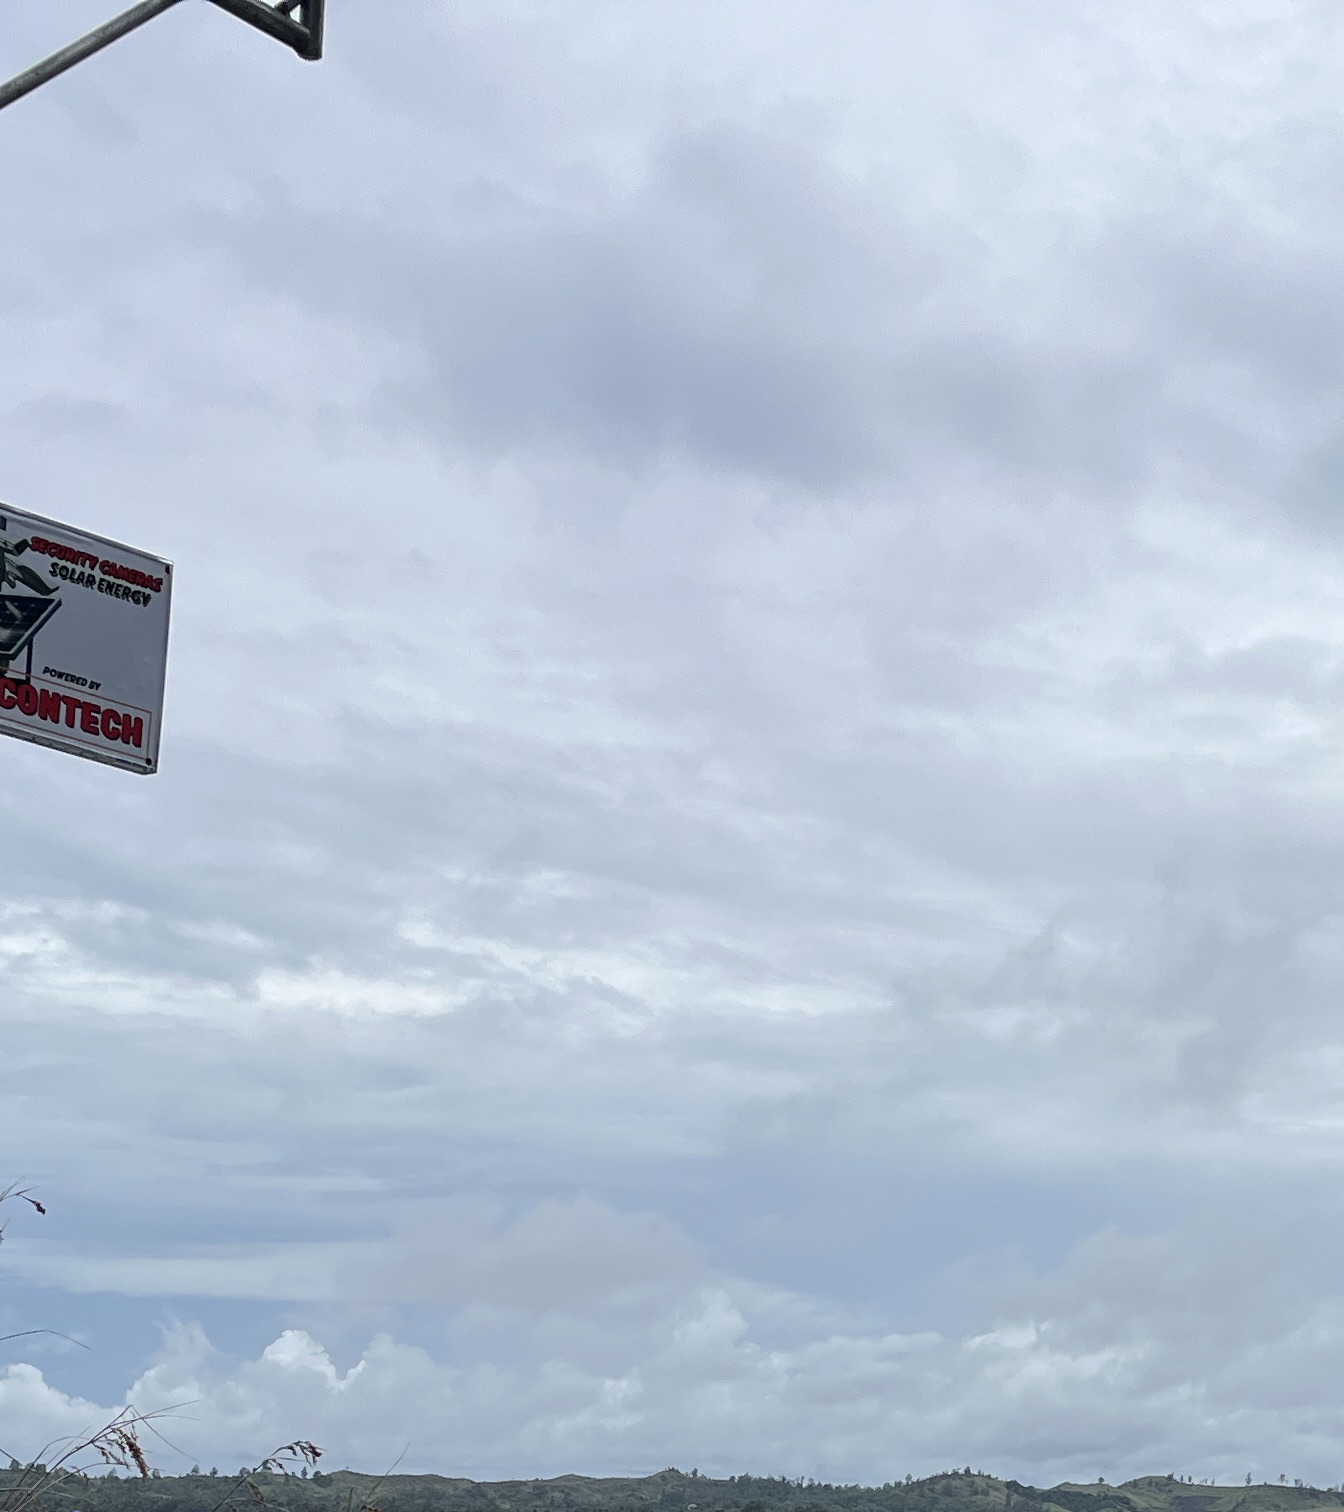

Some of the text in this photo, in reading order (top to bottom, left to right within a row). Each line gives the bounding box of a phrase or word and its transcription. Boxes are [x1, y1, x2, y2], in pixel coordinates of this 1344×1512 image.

[30, 535, 163, 593] SECURITY CAMERAS
[48, 561, 152, 608] SOLAR ENERGY
[42, 665, 102, 692] POWERED BY
